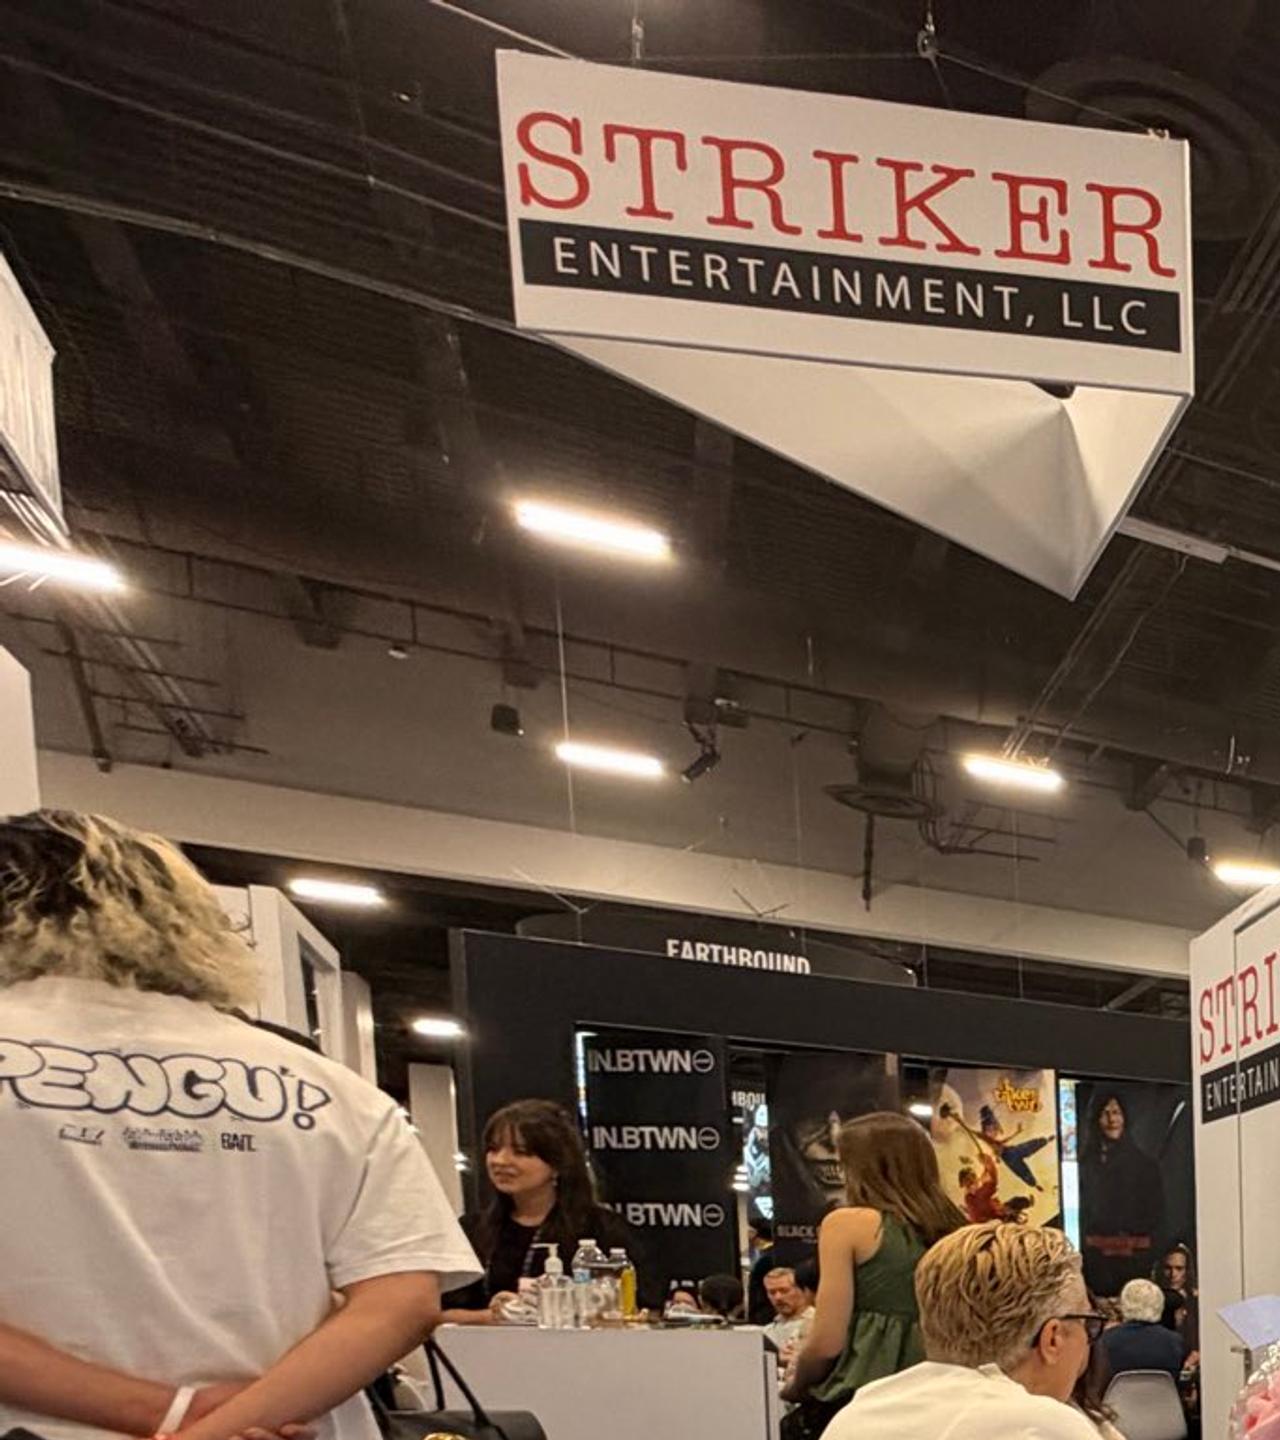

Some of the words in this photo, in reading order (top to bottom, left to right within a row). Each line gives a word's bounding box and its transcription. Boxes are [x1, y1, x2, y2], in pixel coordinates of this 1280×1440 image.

[516, 112, 1177, 278] STRIKER
[553, 237, 1037, 328] ENTERTAINMENT,
[1061, 292, 1148, 335] LLC
[616, 1202, 702, 1227] BTWN
